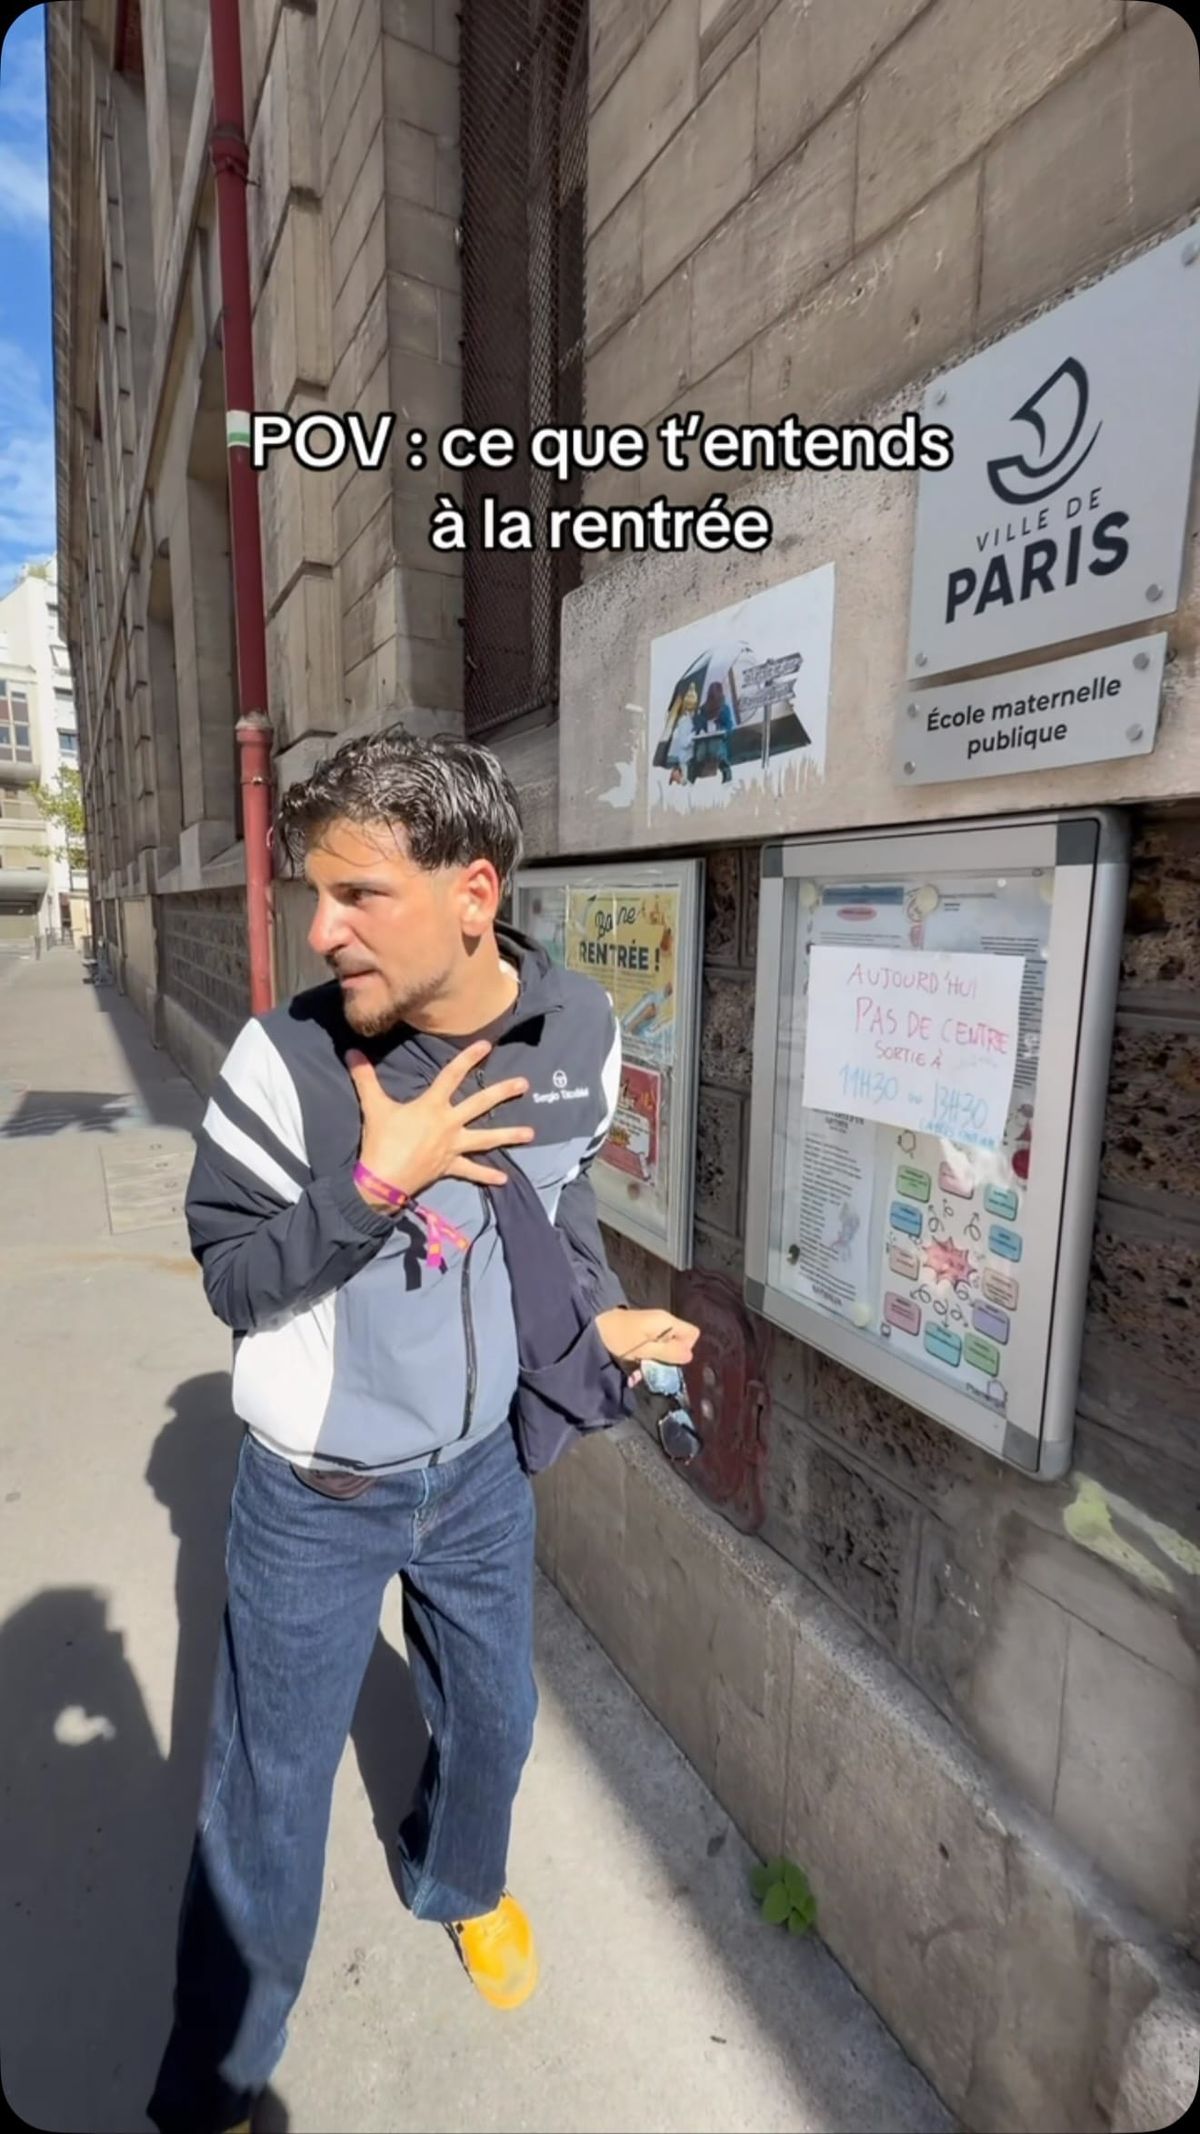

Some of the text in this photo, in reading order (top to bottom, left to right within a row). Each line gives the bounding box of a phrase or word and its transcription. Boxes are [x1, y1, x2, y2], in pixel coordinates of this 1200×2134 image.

[975, 486, 1103, 552] VILLE DE
[944, 510, 1130, 625] PARIS
[926, 676, 1122, 733] École maternelle
[966, 722, 1068, 760] publique
[846, 962, 978, 999] AUJOURD'HUI
[855, 996, 1010, 1055] PAS DE CENTRE
[874, 1039, 927, 1067] SORTIE
